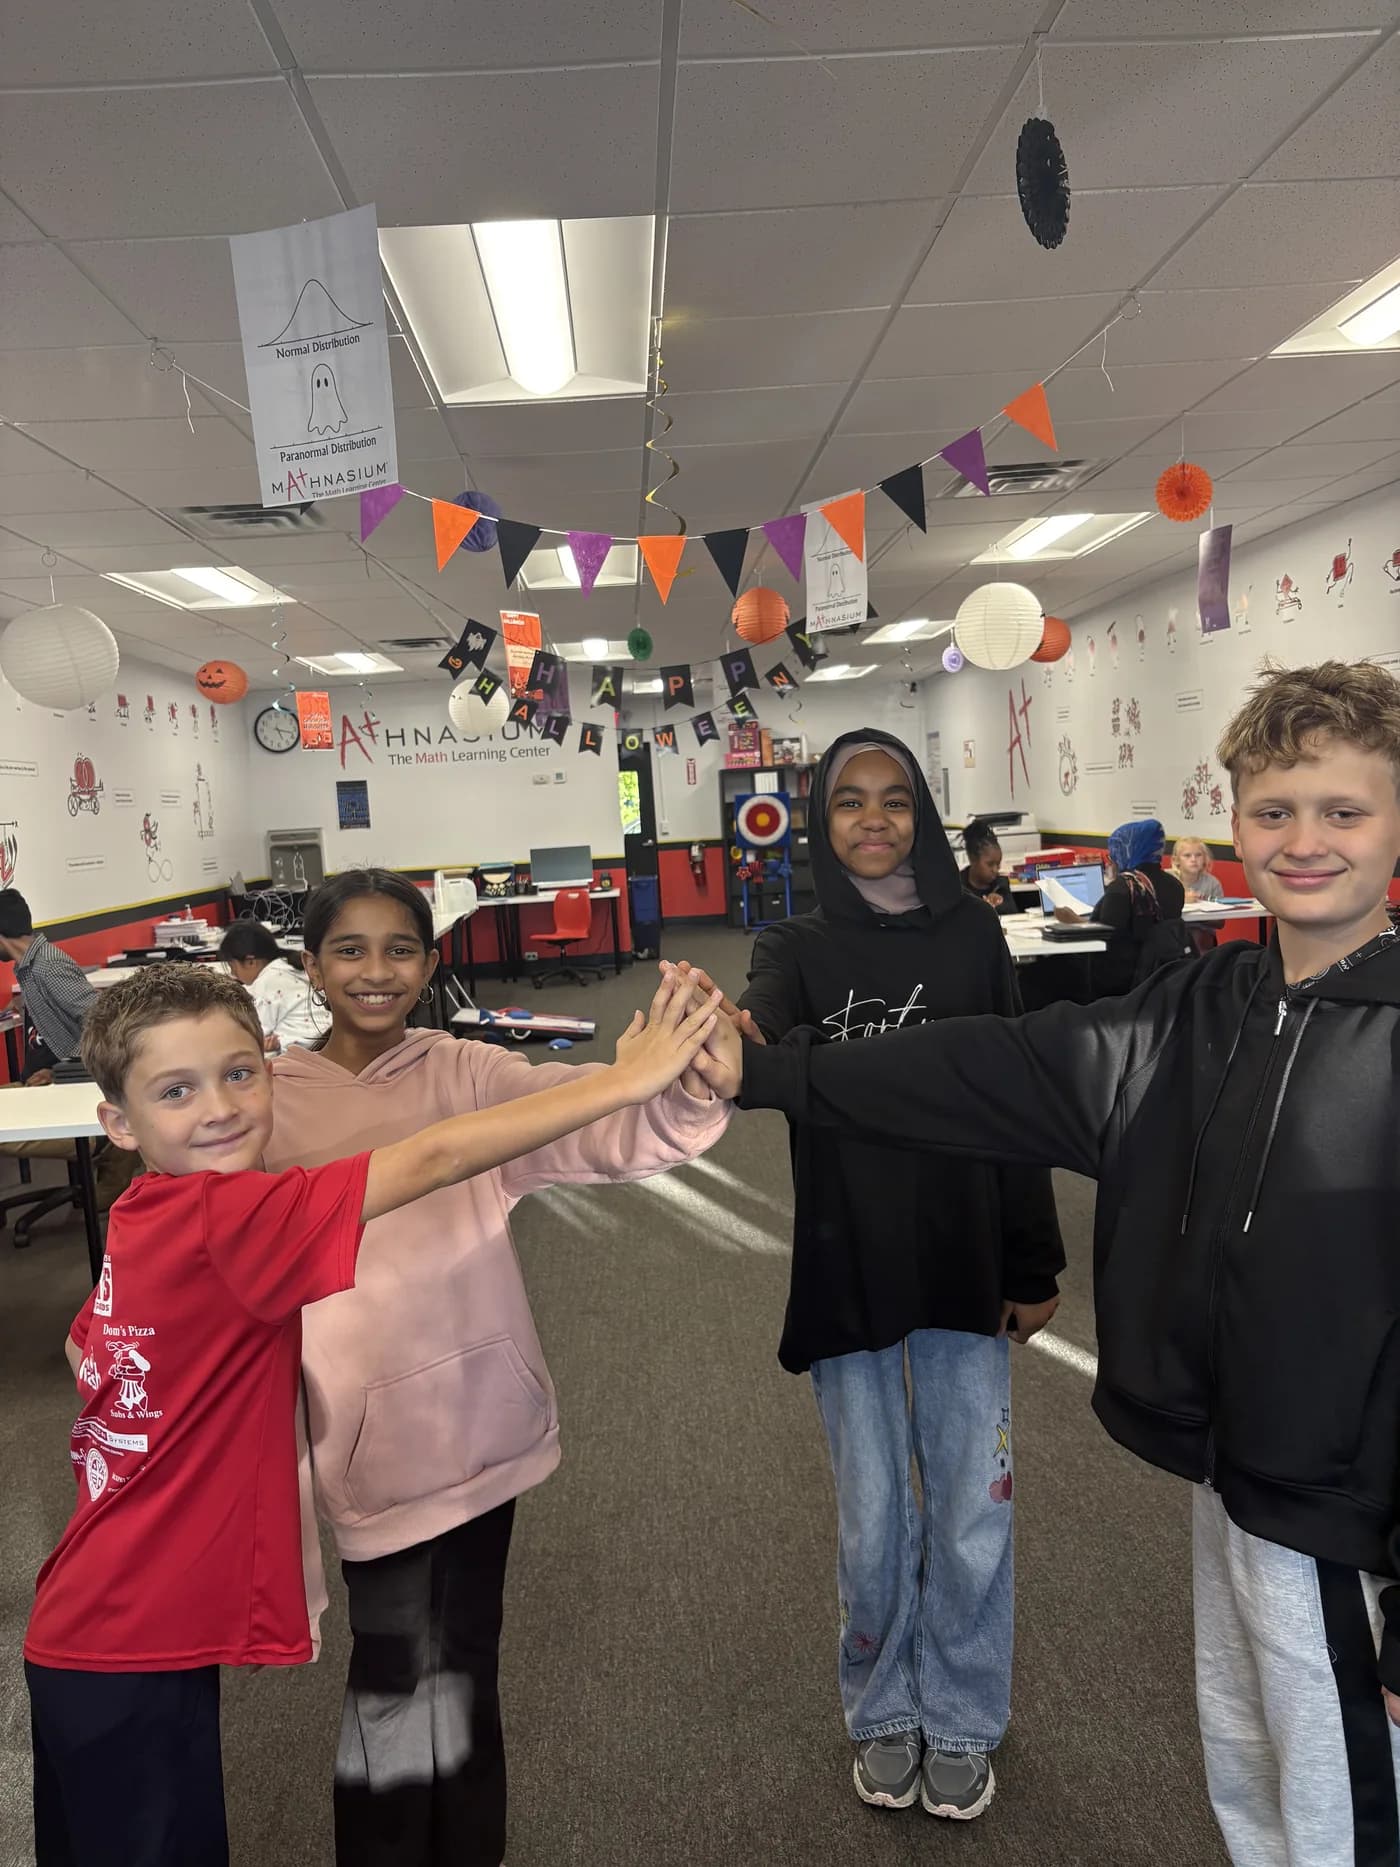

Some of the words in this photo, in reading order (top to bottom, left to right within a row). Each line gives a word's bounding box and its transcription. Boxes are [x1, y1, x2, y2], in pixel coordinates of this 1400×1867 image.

[276, 344, 310, 358] Normal
[312, 335, 361, 352] Distribution
[280, 446, 329, 462] Paranormal
[331, 436, 377, 454] Distribution
[388, 753, 413, 765] The
[415, 751, 448, 764] Math
[451, 747, 508, 762] Learning
[509, 744, 551, 759] Center
[103, 1323, 127, 1337] Dom's
[127, 1325, 156, 1337] Pizza
[136, 1408, 164, 1419] Wings
